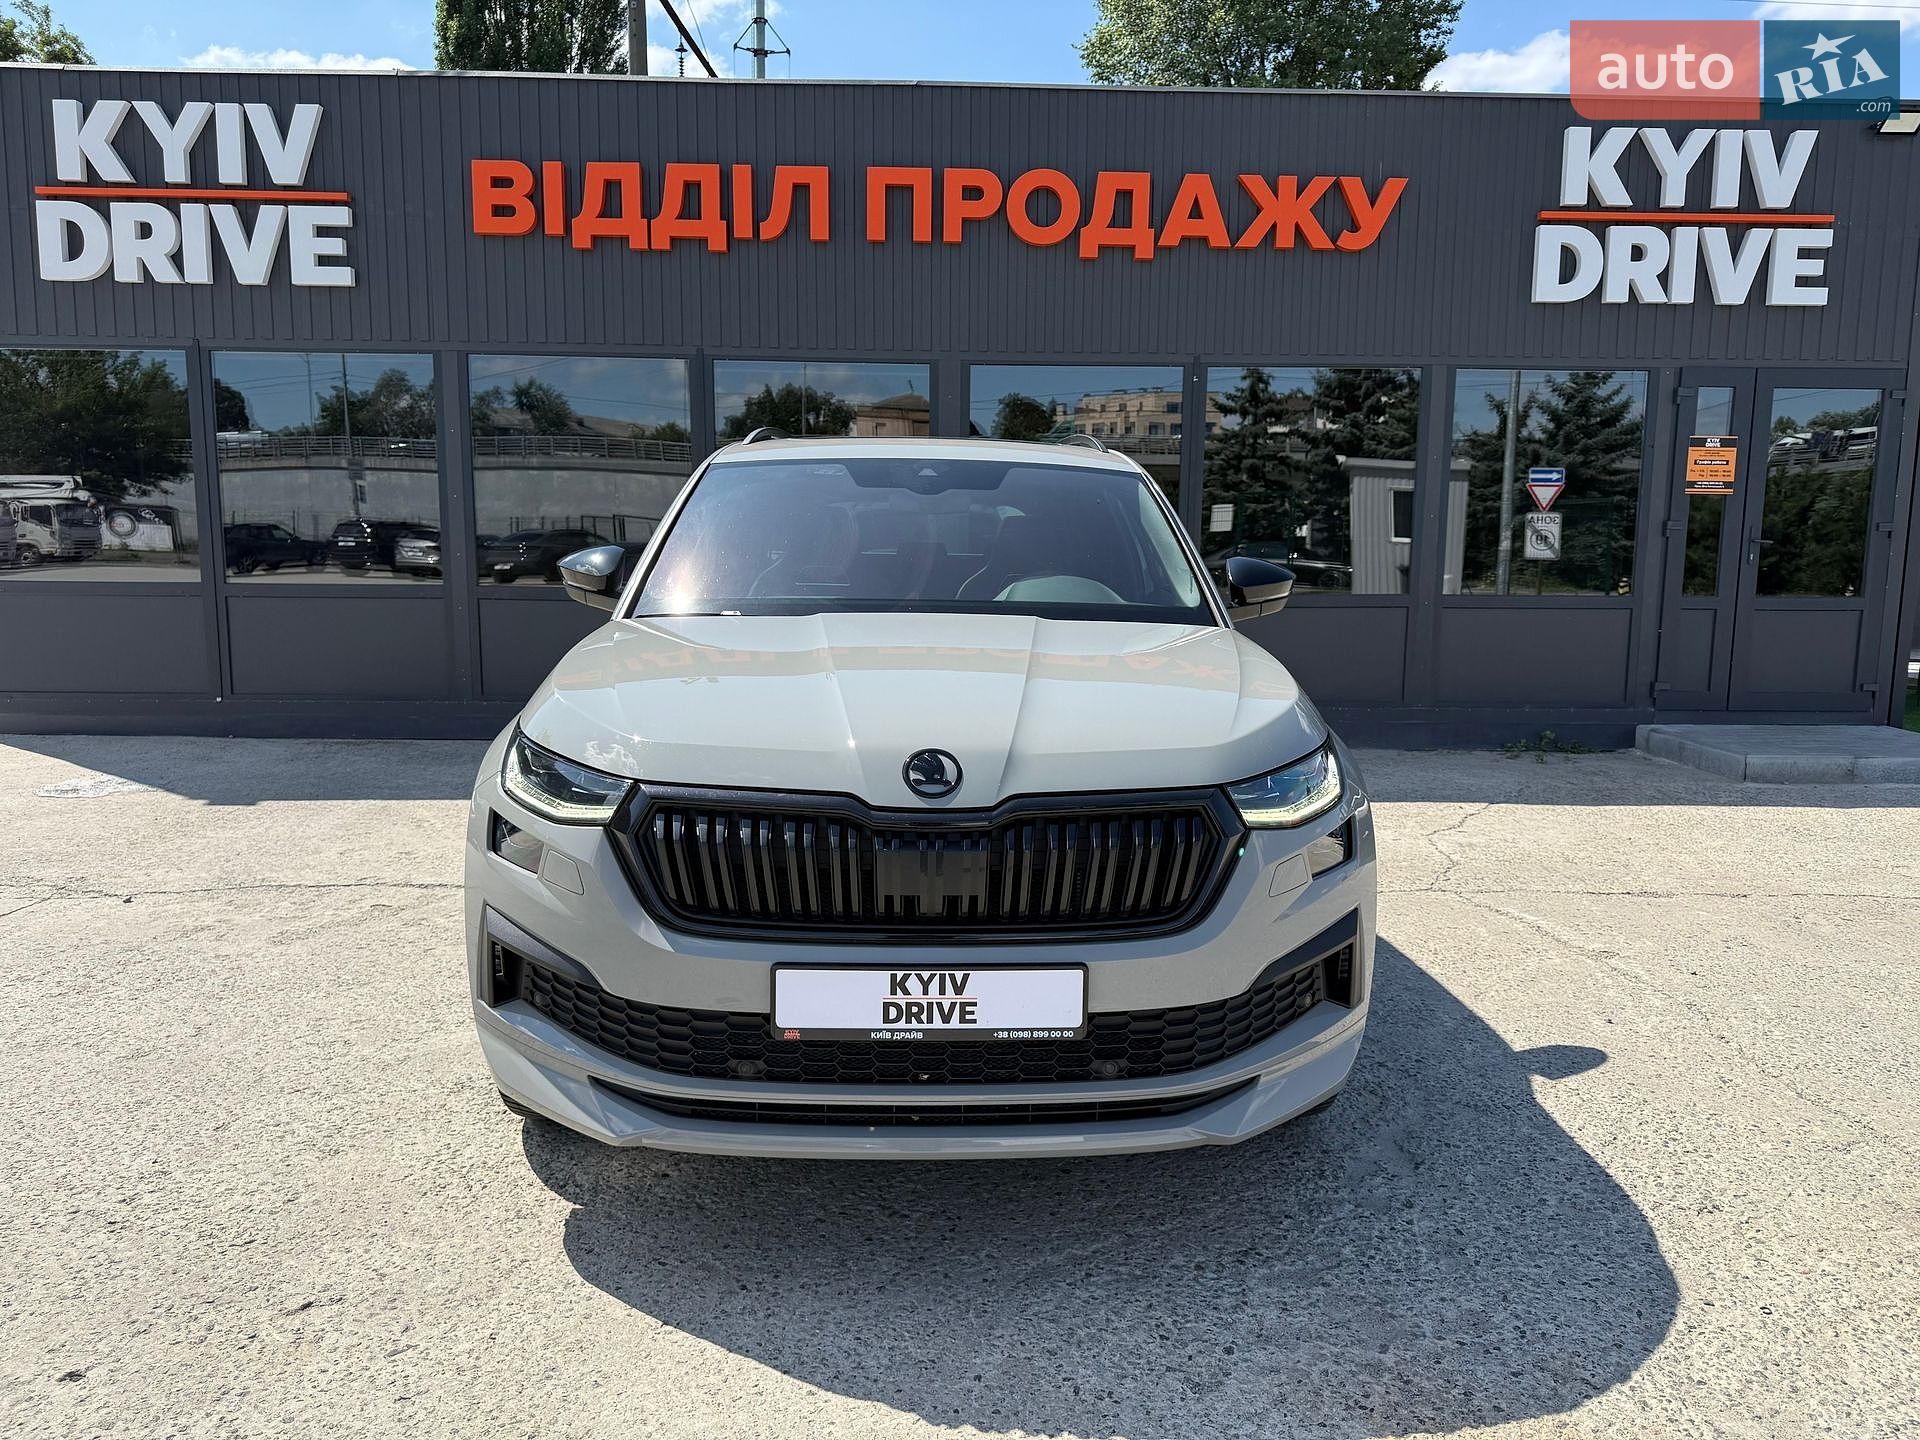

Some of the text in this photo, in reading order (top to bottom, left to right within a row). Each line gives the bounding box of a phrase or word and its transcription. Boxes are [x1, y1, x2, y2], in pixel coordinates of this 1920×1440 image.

[52, 98, 324, 187] KYIV
[1560, 126, 1819, 210] KYIV
[35, 199, 356, 287] DRIVE
[471, 159, 1408, 261] ВІДДІЛ ПРОДАЖУ
[1531, 225, 1834, 307] DRIVE
[882, 1001, 978, 1025] DRIVE
[889, 973, 971, 996] KYIV
[870, 1030, 924, 1040] КИЇВ ДРАЙВ
[993, 1030, 1074, 1039] +38 (098) 899 00 00
